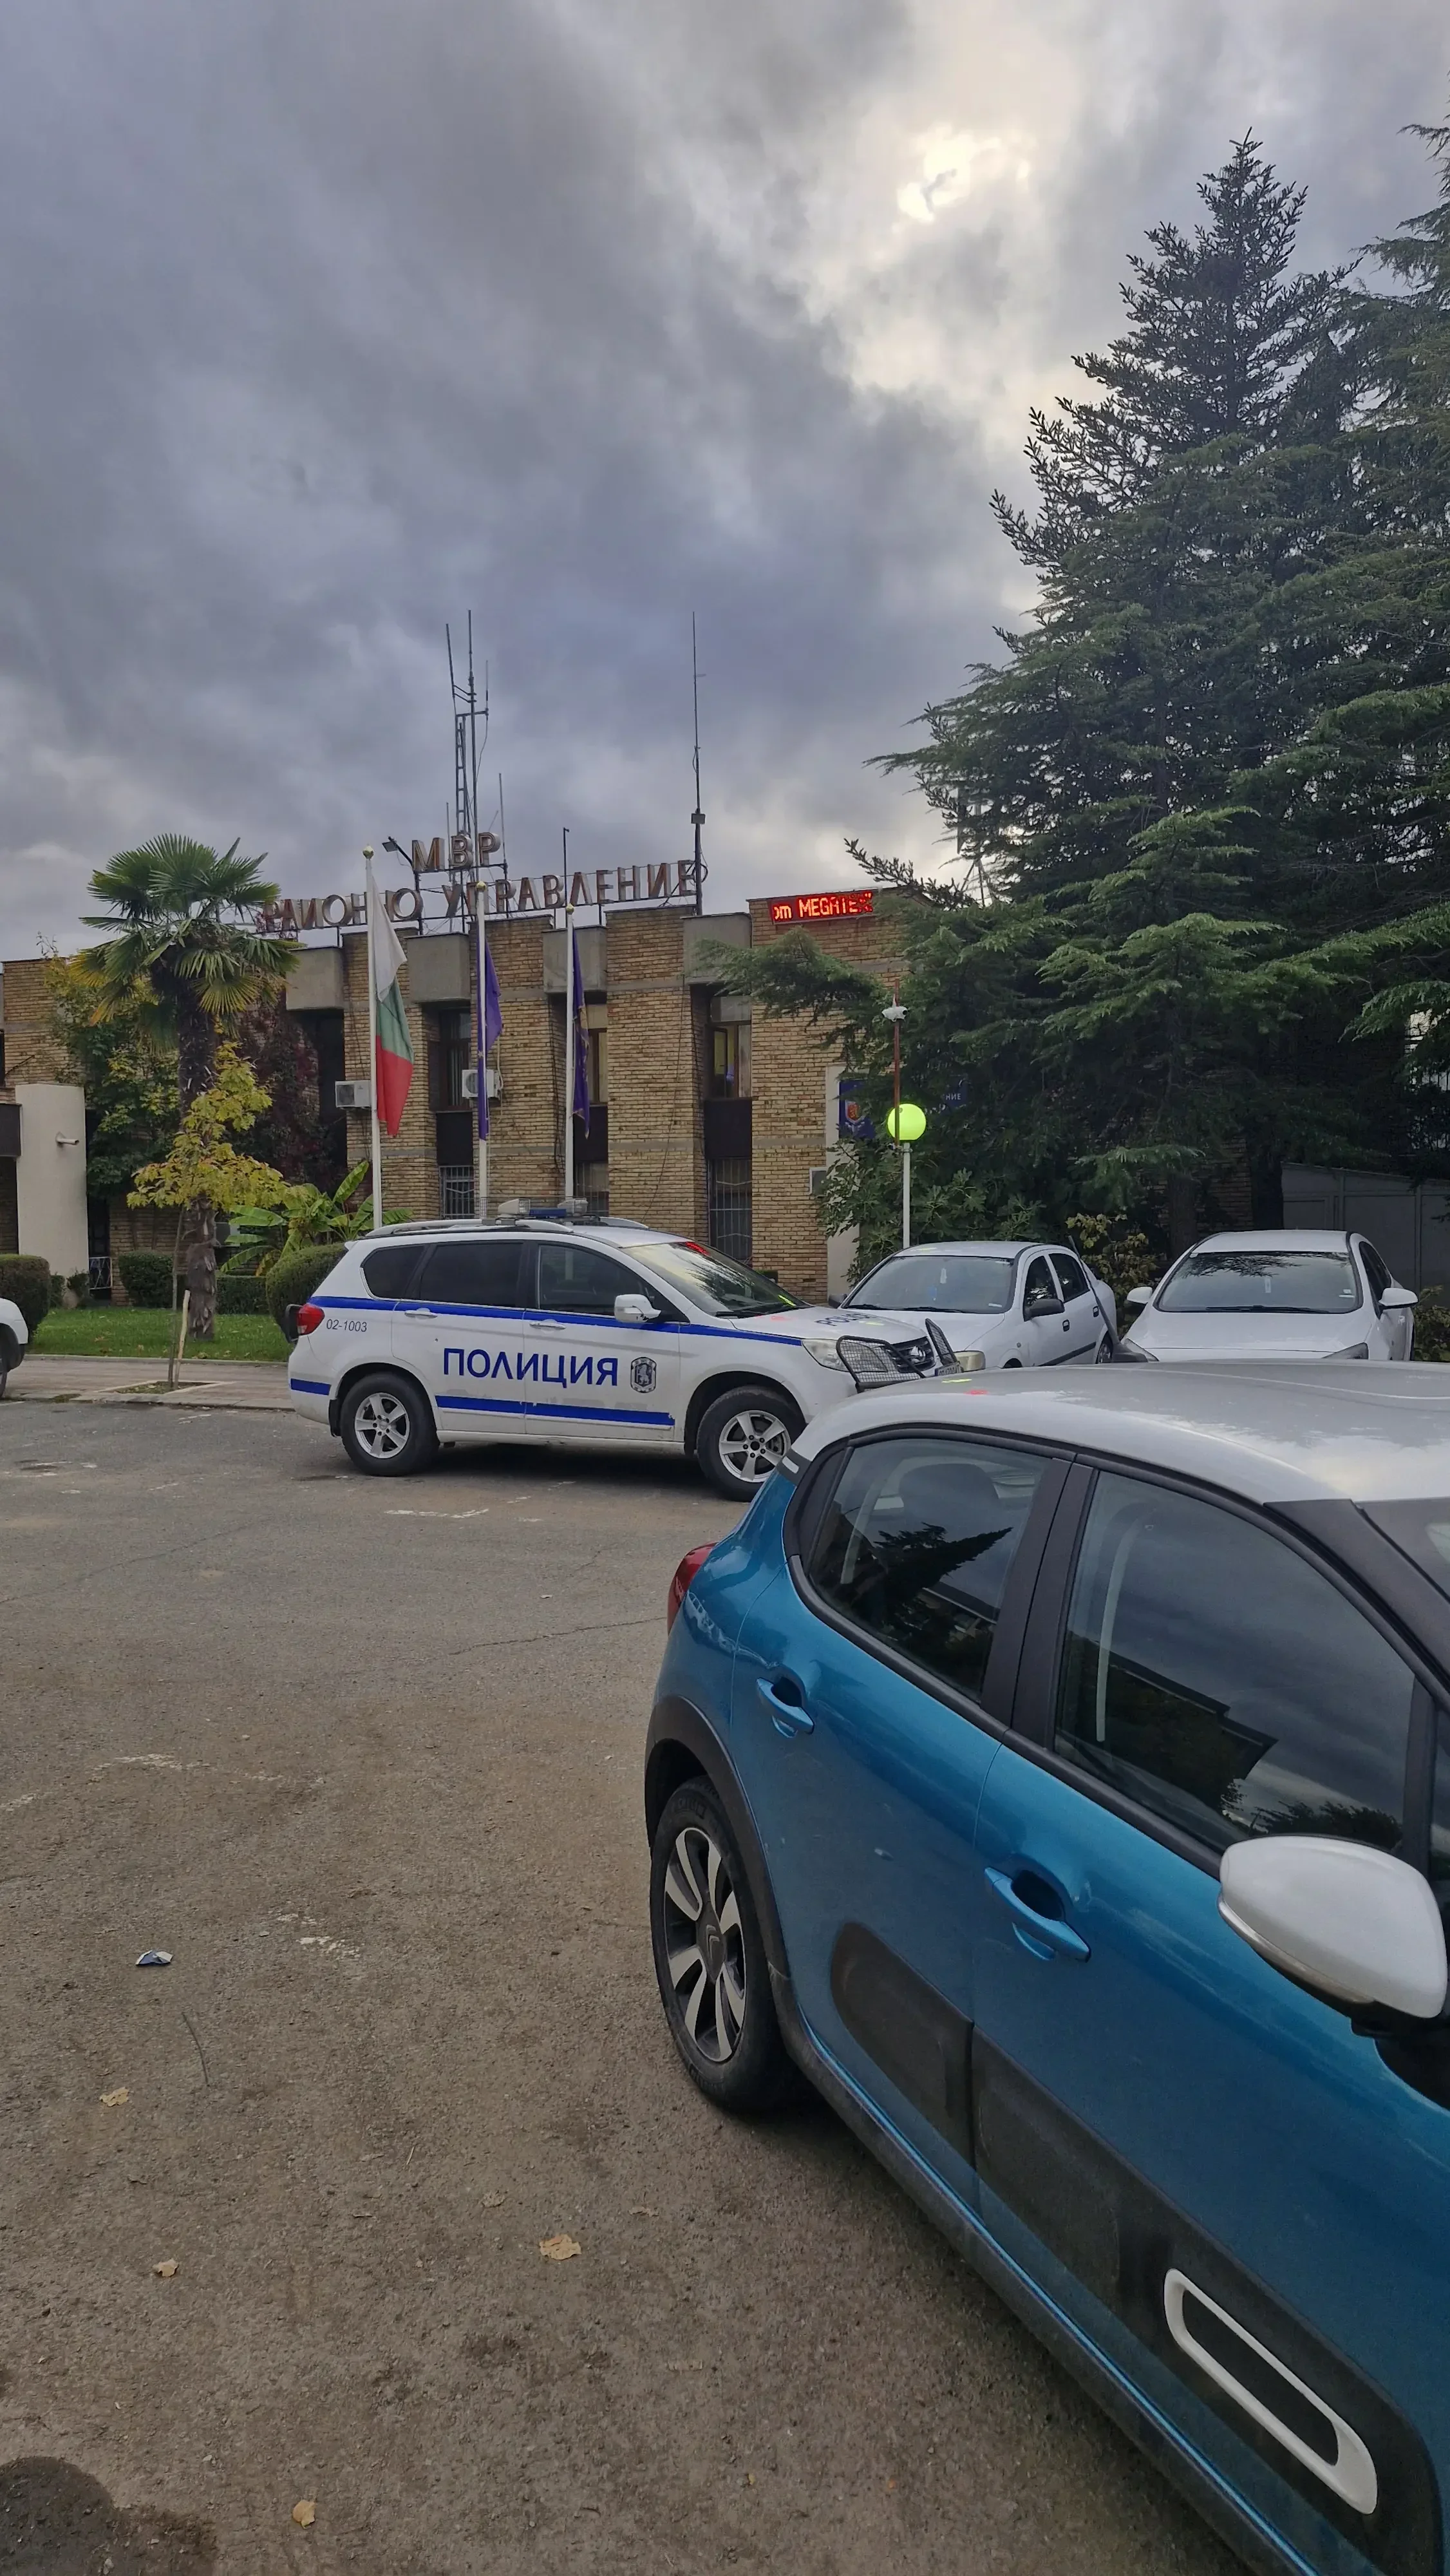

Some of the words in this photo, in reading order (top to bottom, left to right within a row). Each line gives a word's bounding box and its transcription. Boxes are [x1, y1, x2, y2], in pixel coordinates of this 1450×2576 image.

[412, 832, 500, 871] МВР
[442, 860, 697, 918] УПРАВЛЕНИЕ
[326, 1319, 367, 1332] 02-1003
[444, 1348, 618, 1388] ПОЛИЦИЯ
